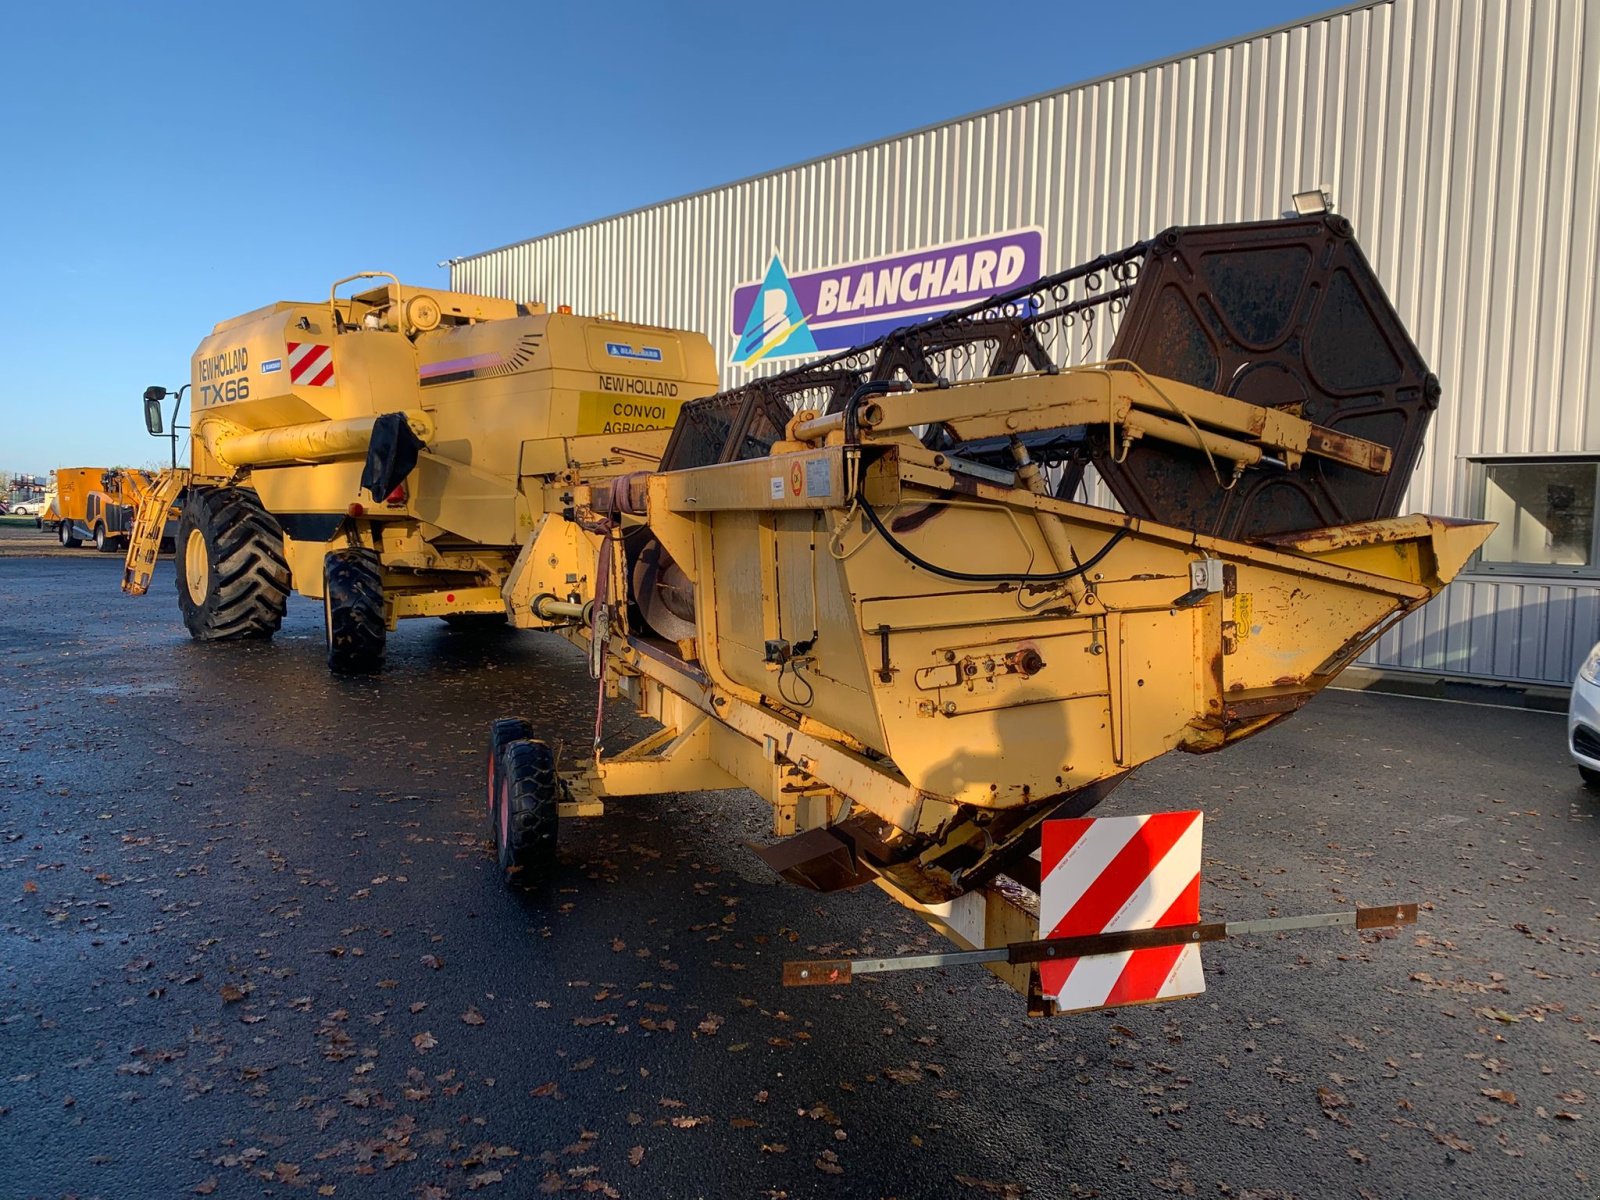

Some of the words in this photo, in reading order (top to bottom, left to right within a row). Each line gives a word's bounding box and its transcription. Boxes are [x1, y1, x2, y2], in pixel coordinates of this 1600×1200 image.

[816, 245, 1026, 316] BLANCHARD
[214, 347, 248, 378] HOLLAND
[200, 377, 249, 406] TX66
[600, 375, 624, 392] NEW
[626, 379, 678, 397] HOLLAND
[613, 403, 666, 419] CONVOI
